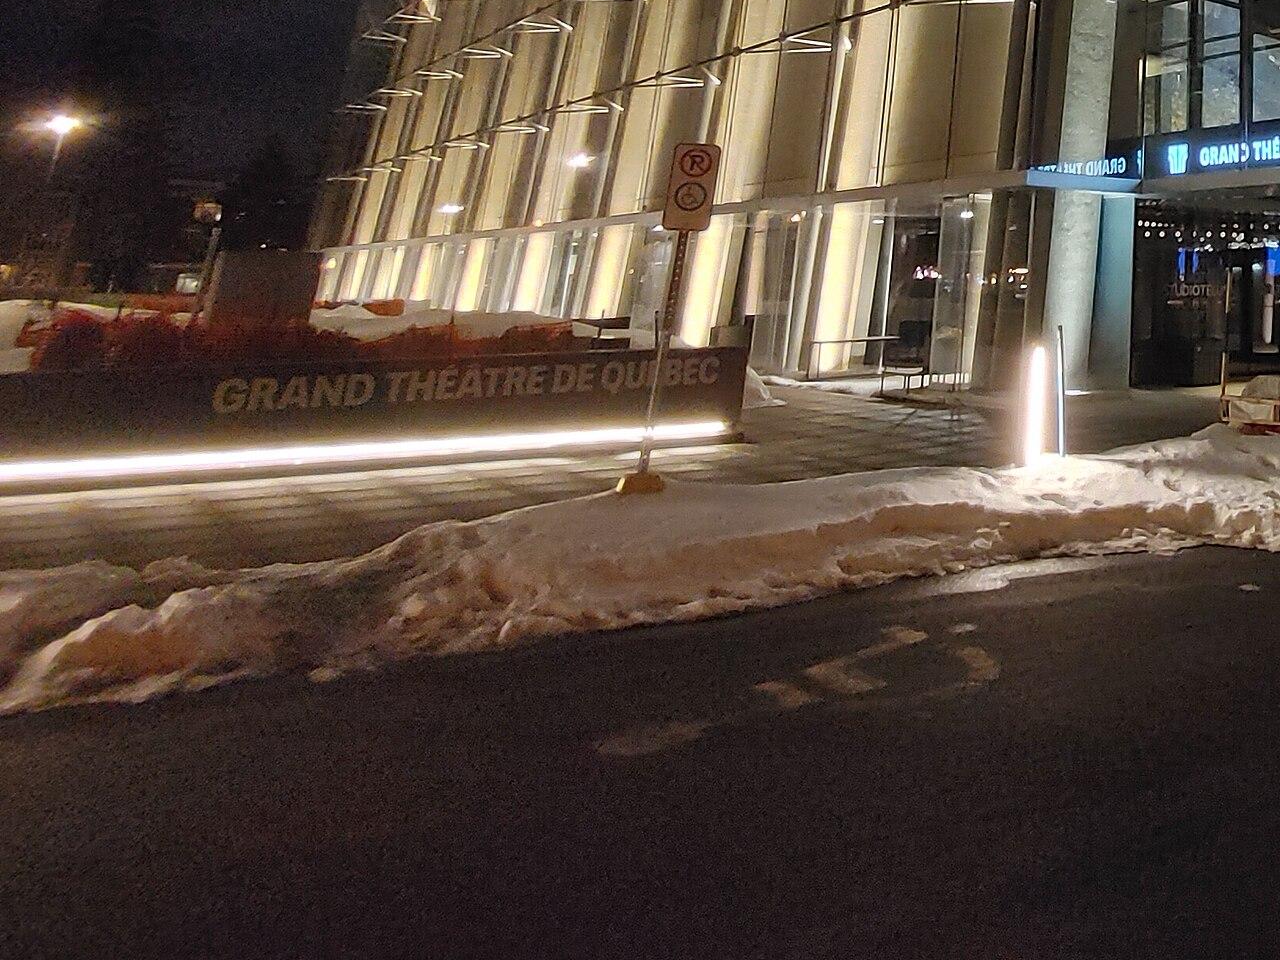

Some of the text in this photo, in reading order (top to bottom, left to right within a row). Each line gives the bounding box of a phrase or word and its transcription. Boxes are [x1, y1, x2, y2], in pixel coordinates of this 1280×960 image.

[1200, 141, 1249, 167] GRAND
[211, 373, 376, 414] GRAND
[552, 363, 598, 394] DE
